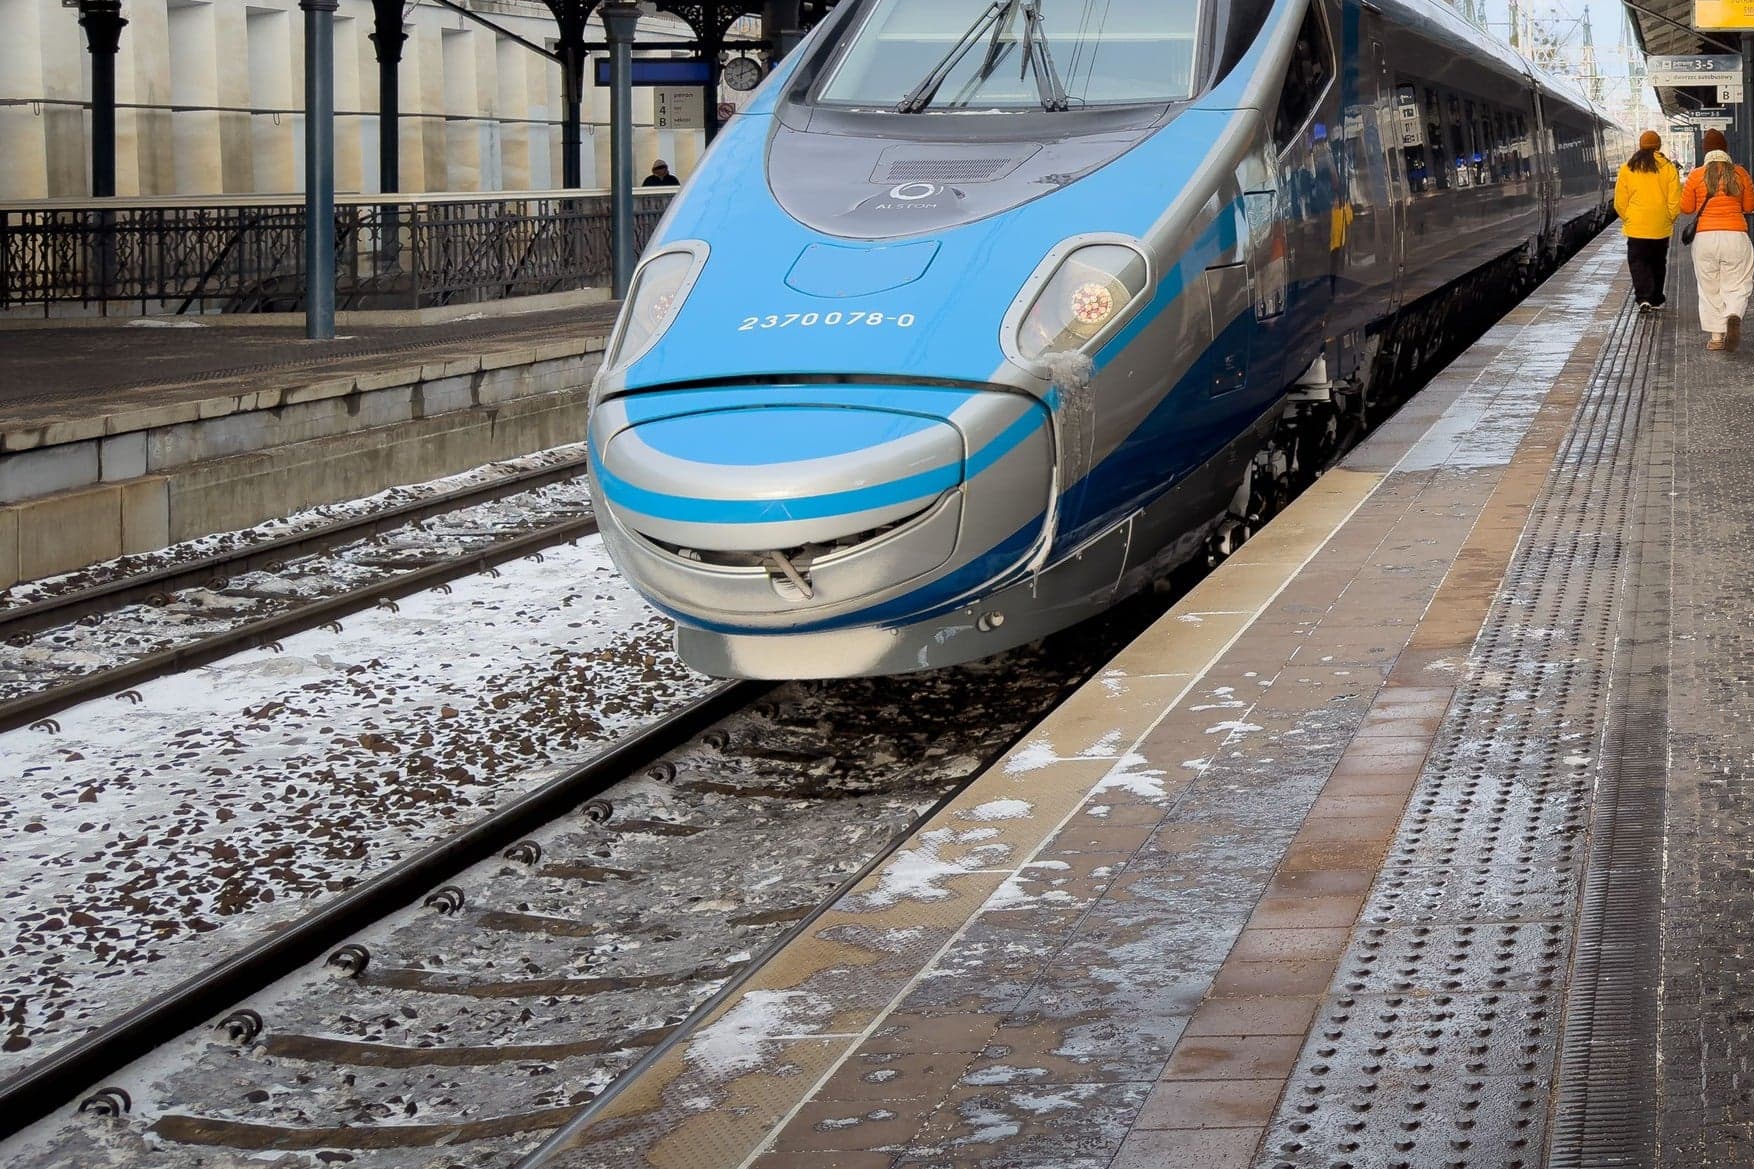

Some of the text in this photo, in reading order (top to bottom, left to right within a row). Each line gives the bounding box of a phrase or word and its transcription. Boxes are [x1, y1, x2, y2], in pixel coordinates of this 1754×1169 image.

[1695, 59, 1714, 70] 3-5
[659, 93, 665, 103] 1
[1722, 91, 1730, 100] B
[659, 106, 666, 115] 4
